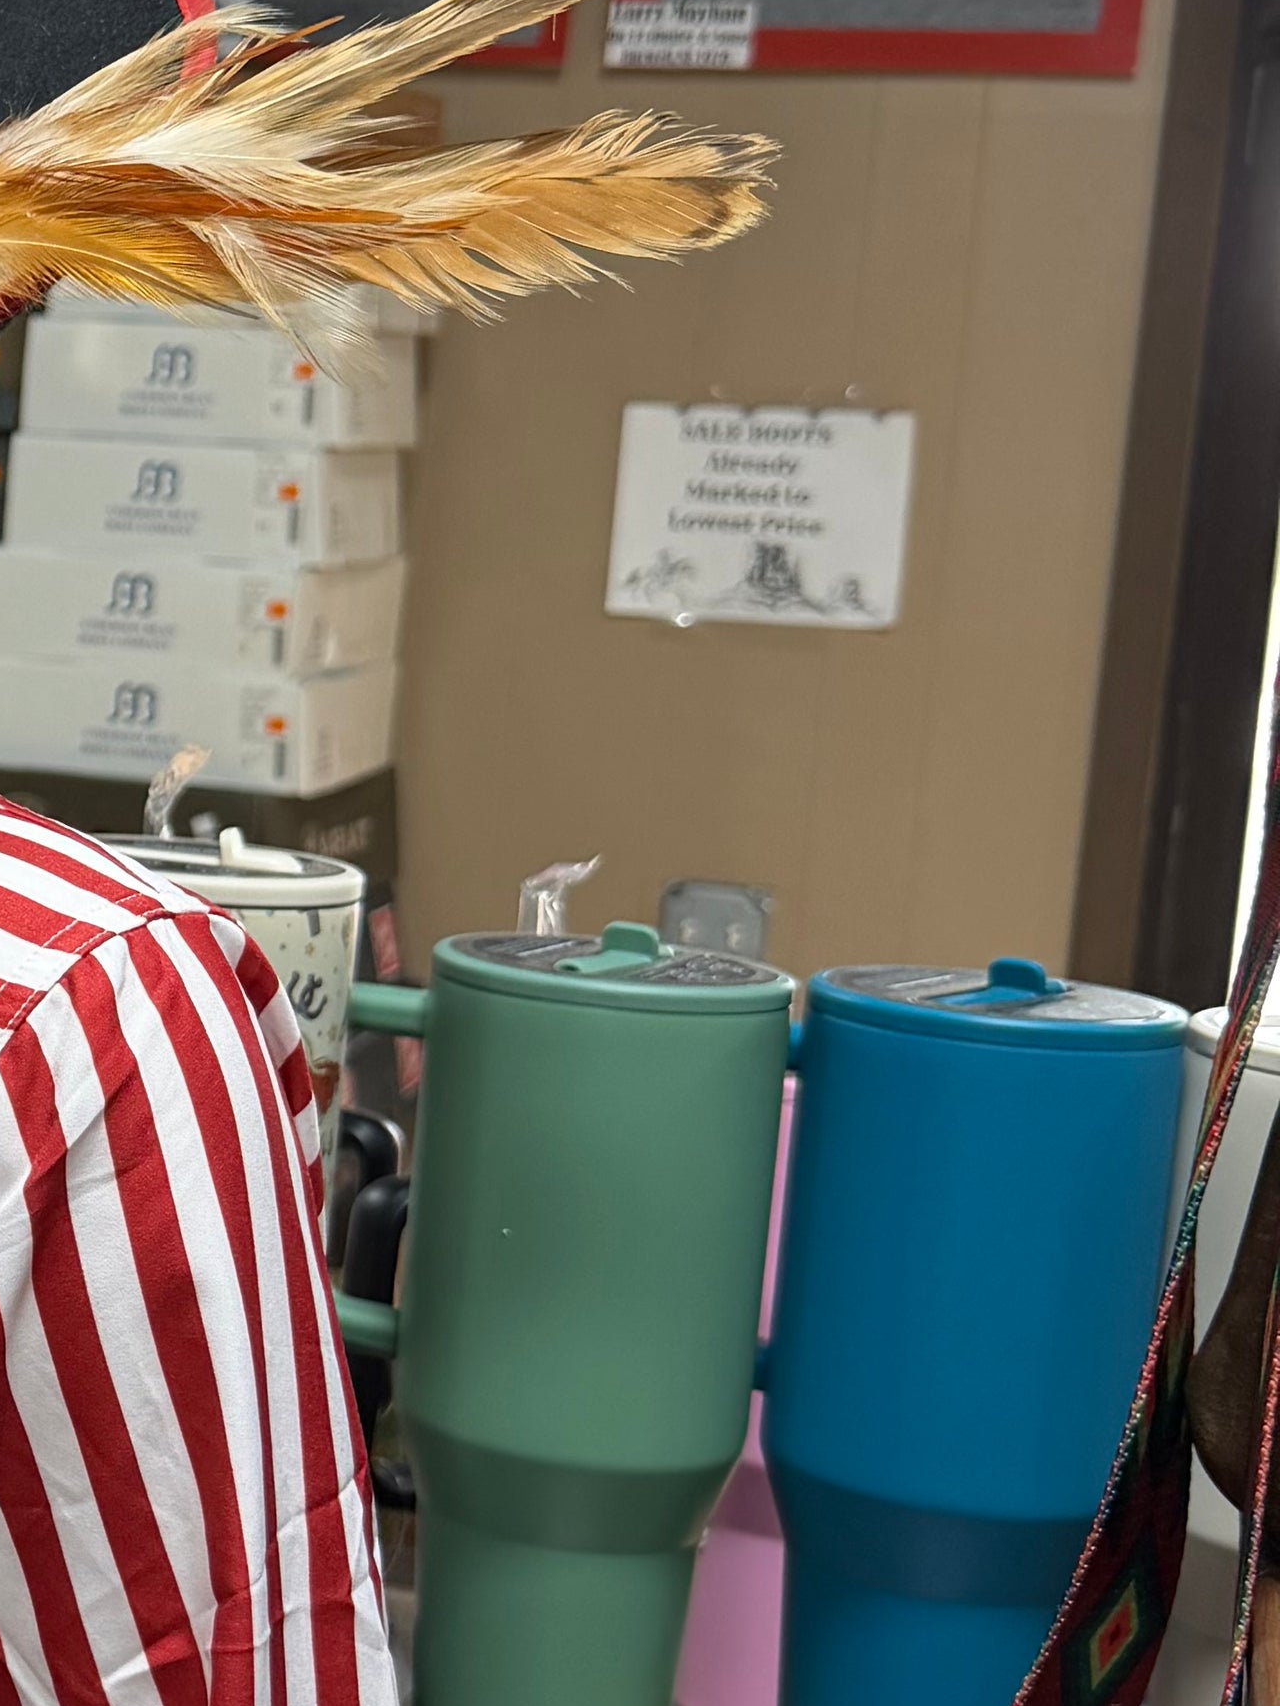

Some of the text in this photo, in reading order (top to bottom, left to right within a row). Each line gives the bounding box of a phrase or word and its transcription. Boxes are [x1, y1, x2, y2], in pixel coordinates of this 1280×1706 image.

[681, 419, 742, 442] SALE
[704, 448, 800, 475] Already
[684, 478, 781, 504] Marked
[667, 506, 826, 535] Lowest Price
